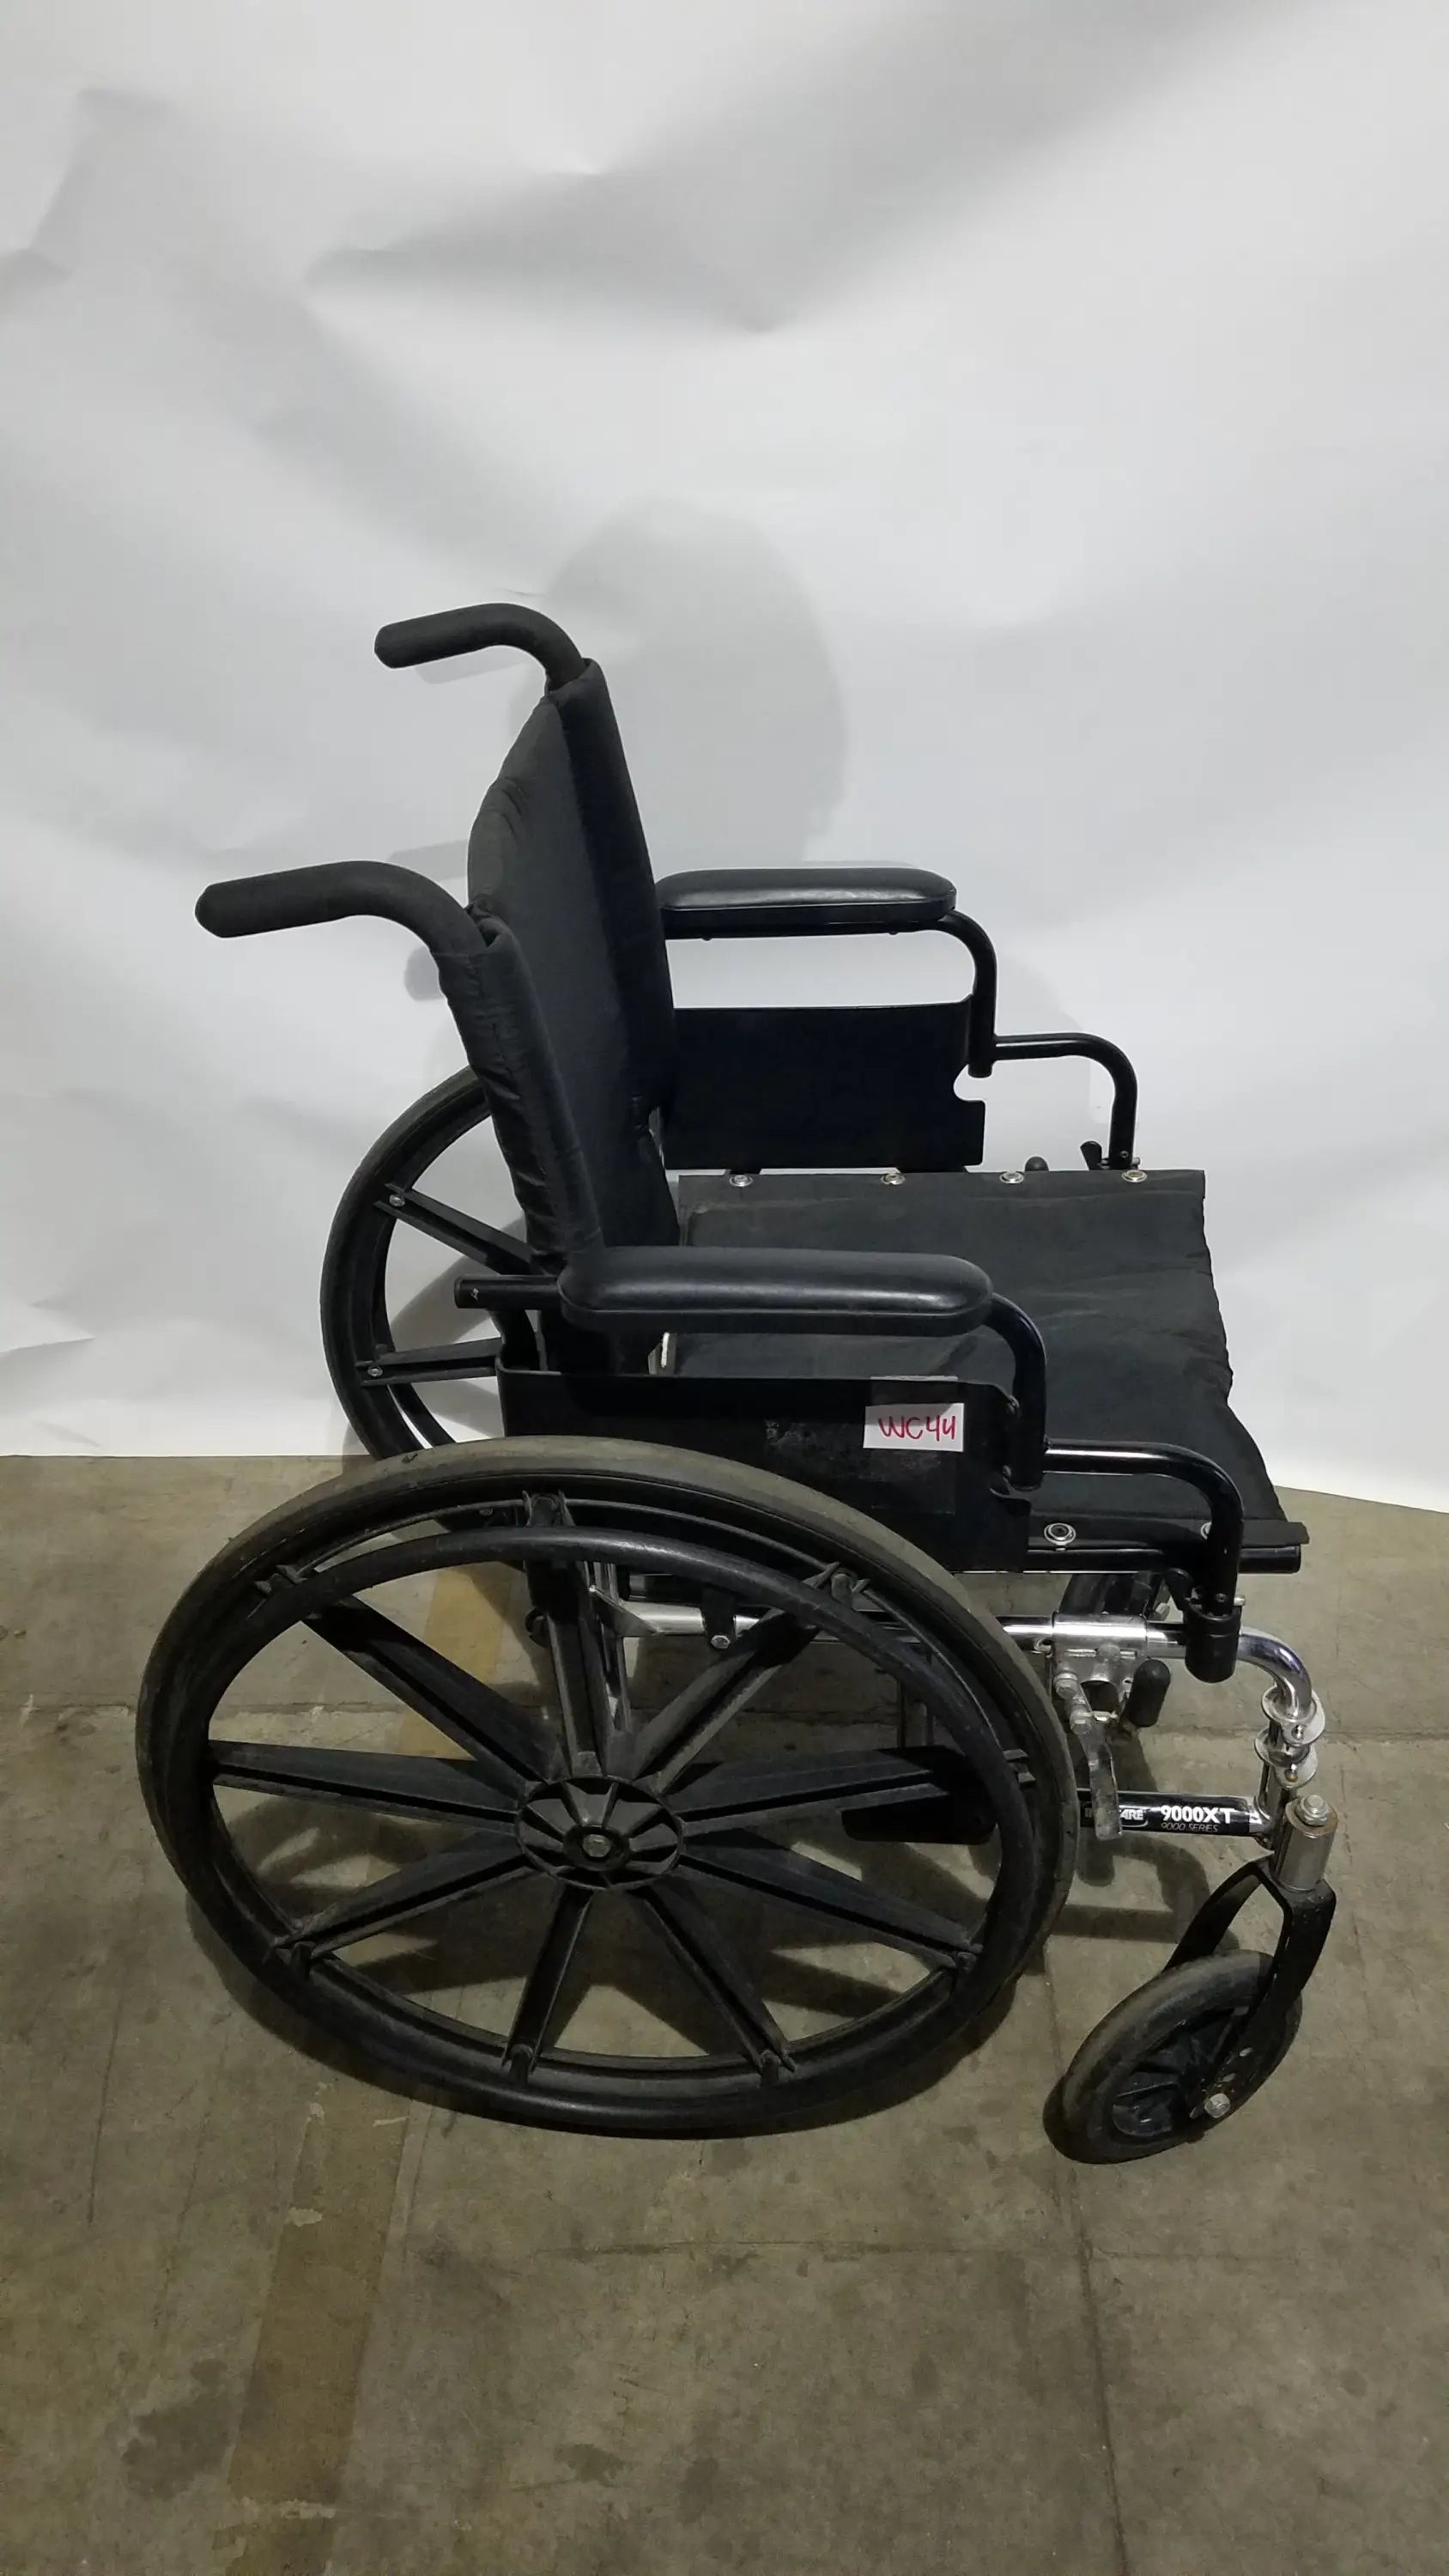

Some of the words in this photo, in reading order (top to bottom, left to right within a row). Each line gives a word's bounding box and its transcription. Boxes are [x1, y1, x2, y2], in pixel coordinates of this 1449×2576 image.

[878, 1415, 956, 1442] WC44
[1160, 1805, 1234, 1824] 9000XT
[1161, 1821, 1185, 1831] 9000
[1189, 1822, 1218, 1832] SERIES
